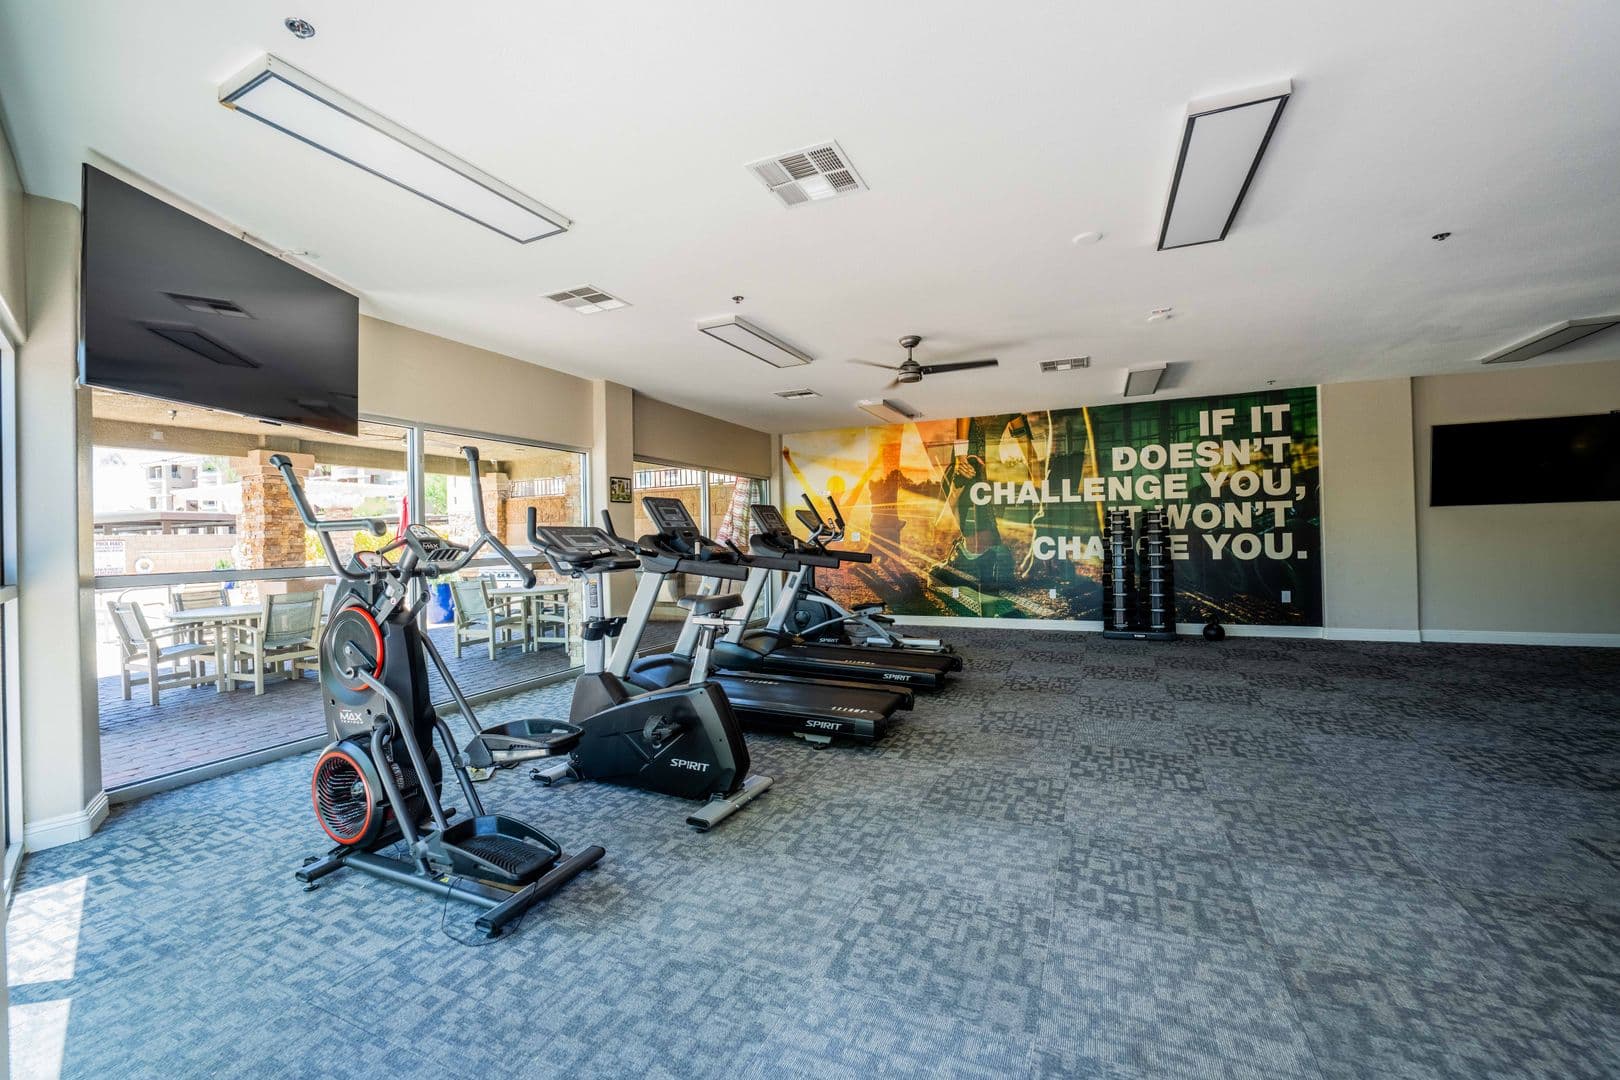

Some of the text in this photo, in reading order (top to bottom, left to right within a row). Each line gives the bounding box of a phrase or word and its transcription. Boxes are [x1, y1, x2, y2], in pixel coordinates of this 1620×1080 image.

[1199, 403, 1291, 437] IF IT
[1111, 435, 1291, 472] DOESN'T
[969, 468, 1306, 506] CHALLENGE YOU,
[1033, 532, 1308, 561] CHAE YOU.
[882, 673, 912, 682] SPIRIT
[339, 711, 362, 722] MAX
[805, 720, 843, 731] SPIRIT
[669, 758, 711, 773] SPIRIT
